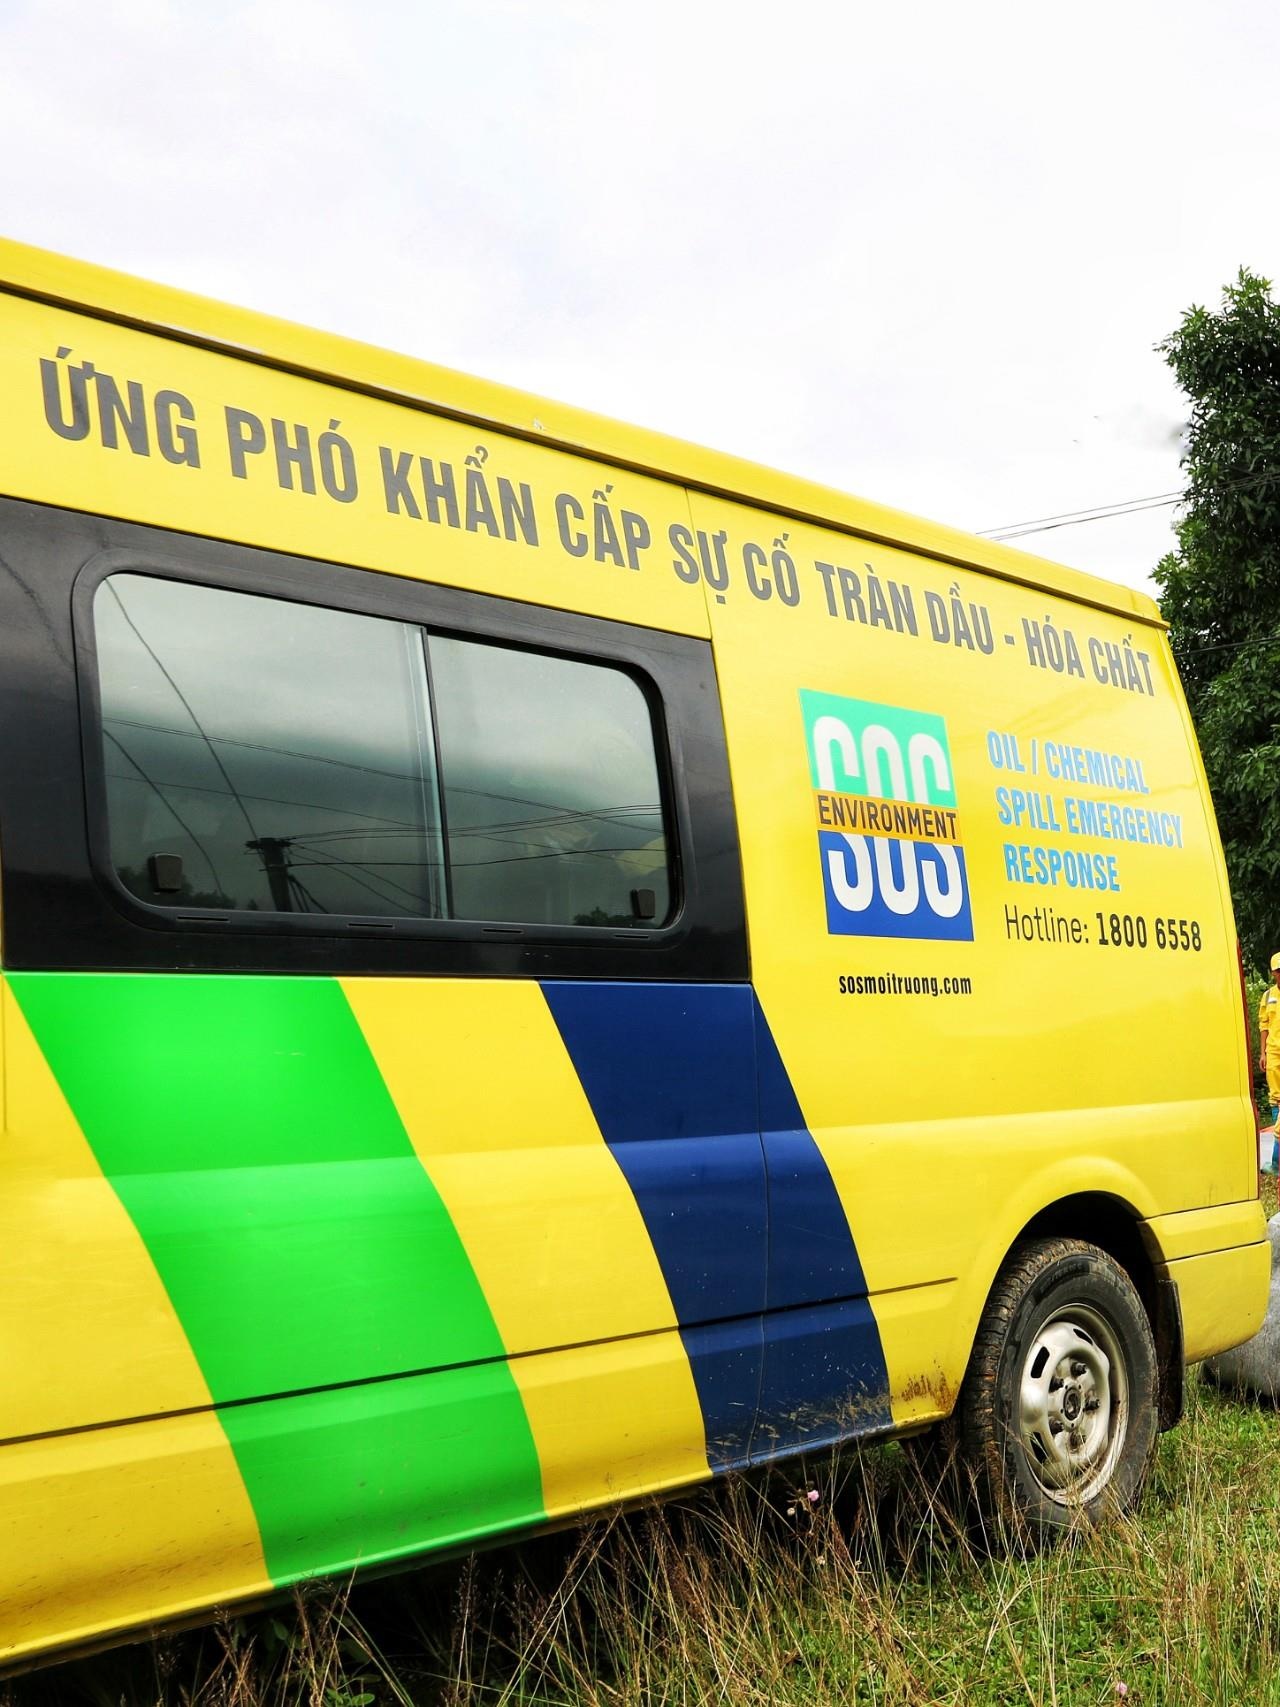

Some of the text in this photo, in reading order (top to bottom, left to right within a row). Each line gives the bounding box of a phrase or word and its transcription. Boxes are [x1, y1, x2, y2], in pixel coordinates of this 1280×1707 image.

[39, 346, 201, 469] ỨNG
[224, 405, 359, 504] PHÓ
[378, 444, 539, 547] KHẨN
[555, 484, 651, 571] CẤP
[668, 523, 729, 605] SỰ
[742, 532, 801, 608] CỐ
[814, 561, 919, 637] TRÀN
[923, 580, 994, 655] DẦU
[1021, 615, 1085, 679] HÓA
[1088, 632, 1155, 697] CHẤT
[986, 730, 1150, 794] OIL / CHEMICAL
[817, 796, 957, 840] ENVIRONMENT
[995, 786, 1182, 849] SPILL EMERGENCY
[1003, 843, 1120, 892] RESPONSE
[1005, 904, 1202, 952] Hotline: 1800 6558
[838, 972, 972, 996] sosmoitruong.com
